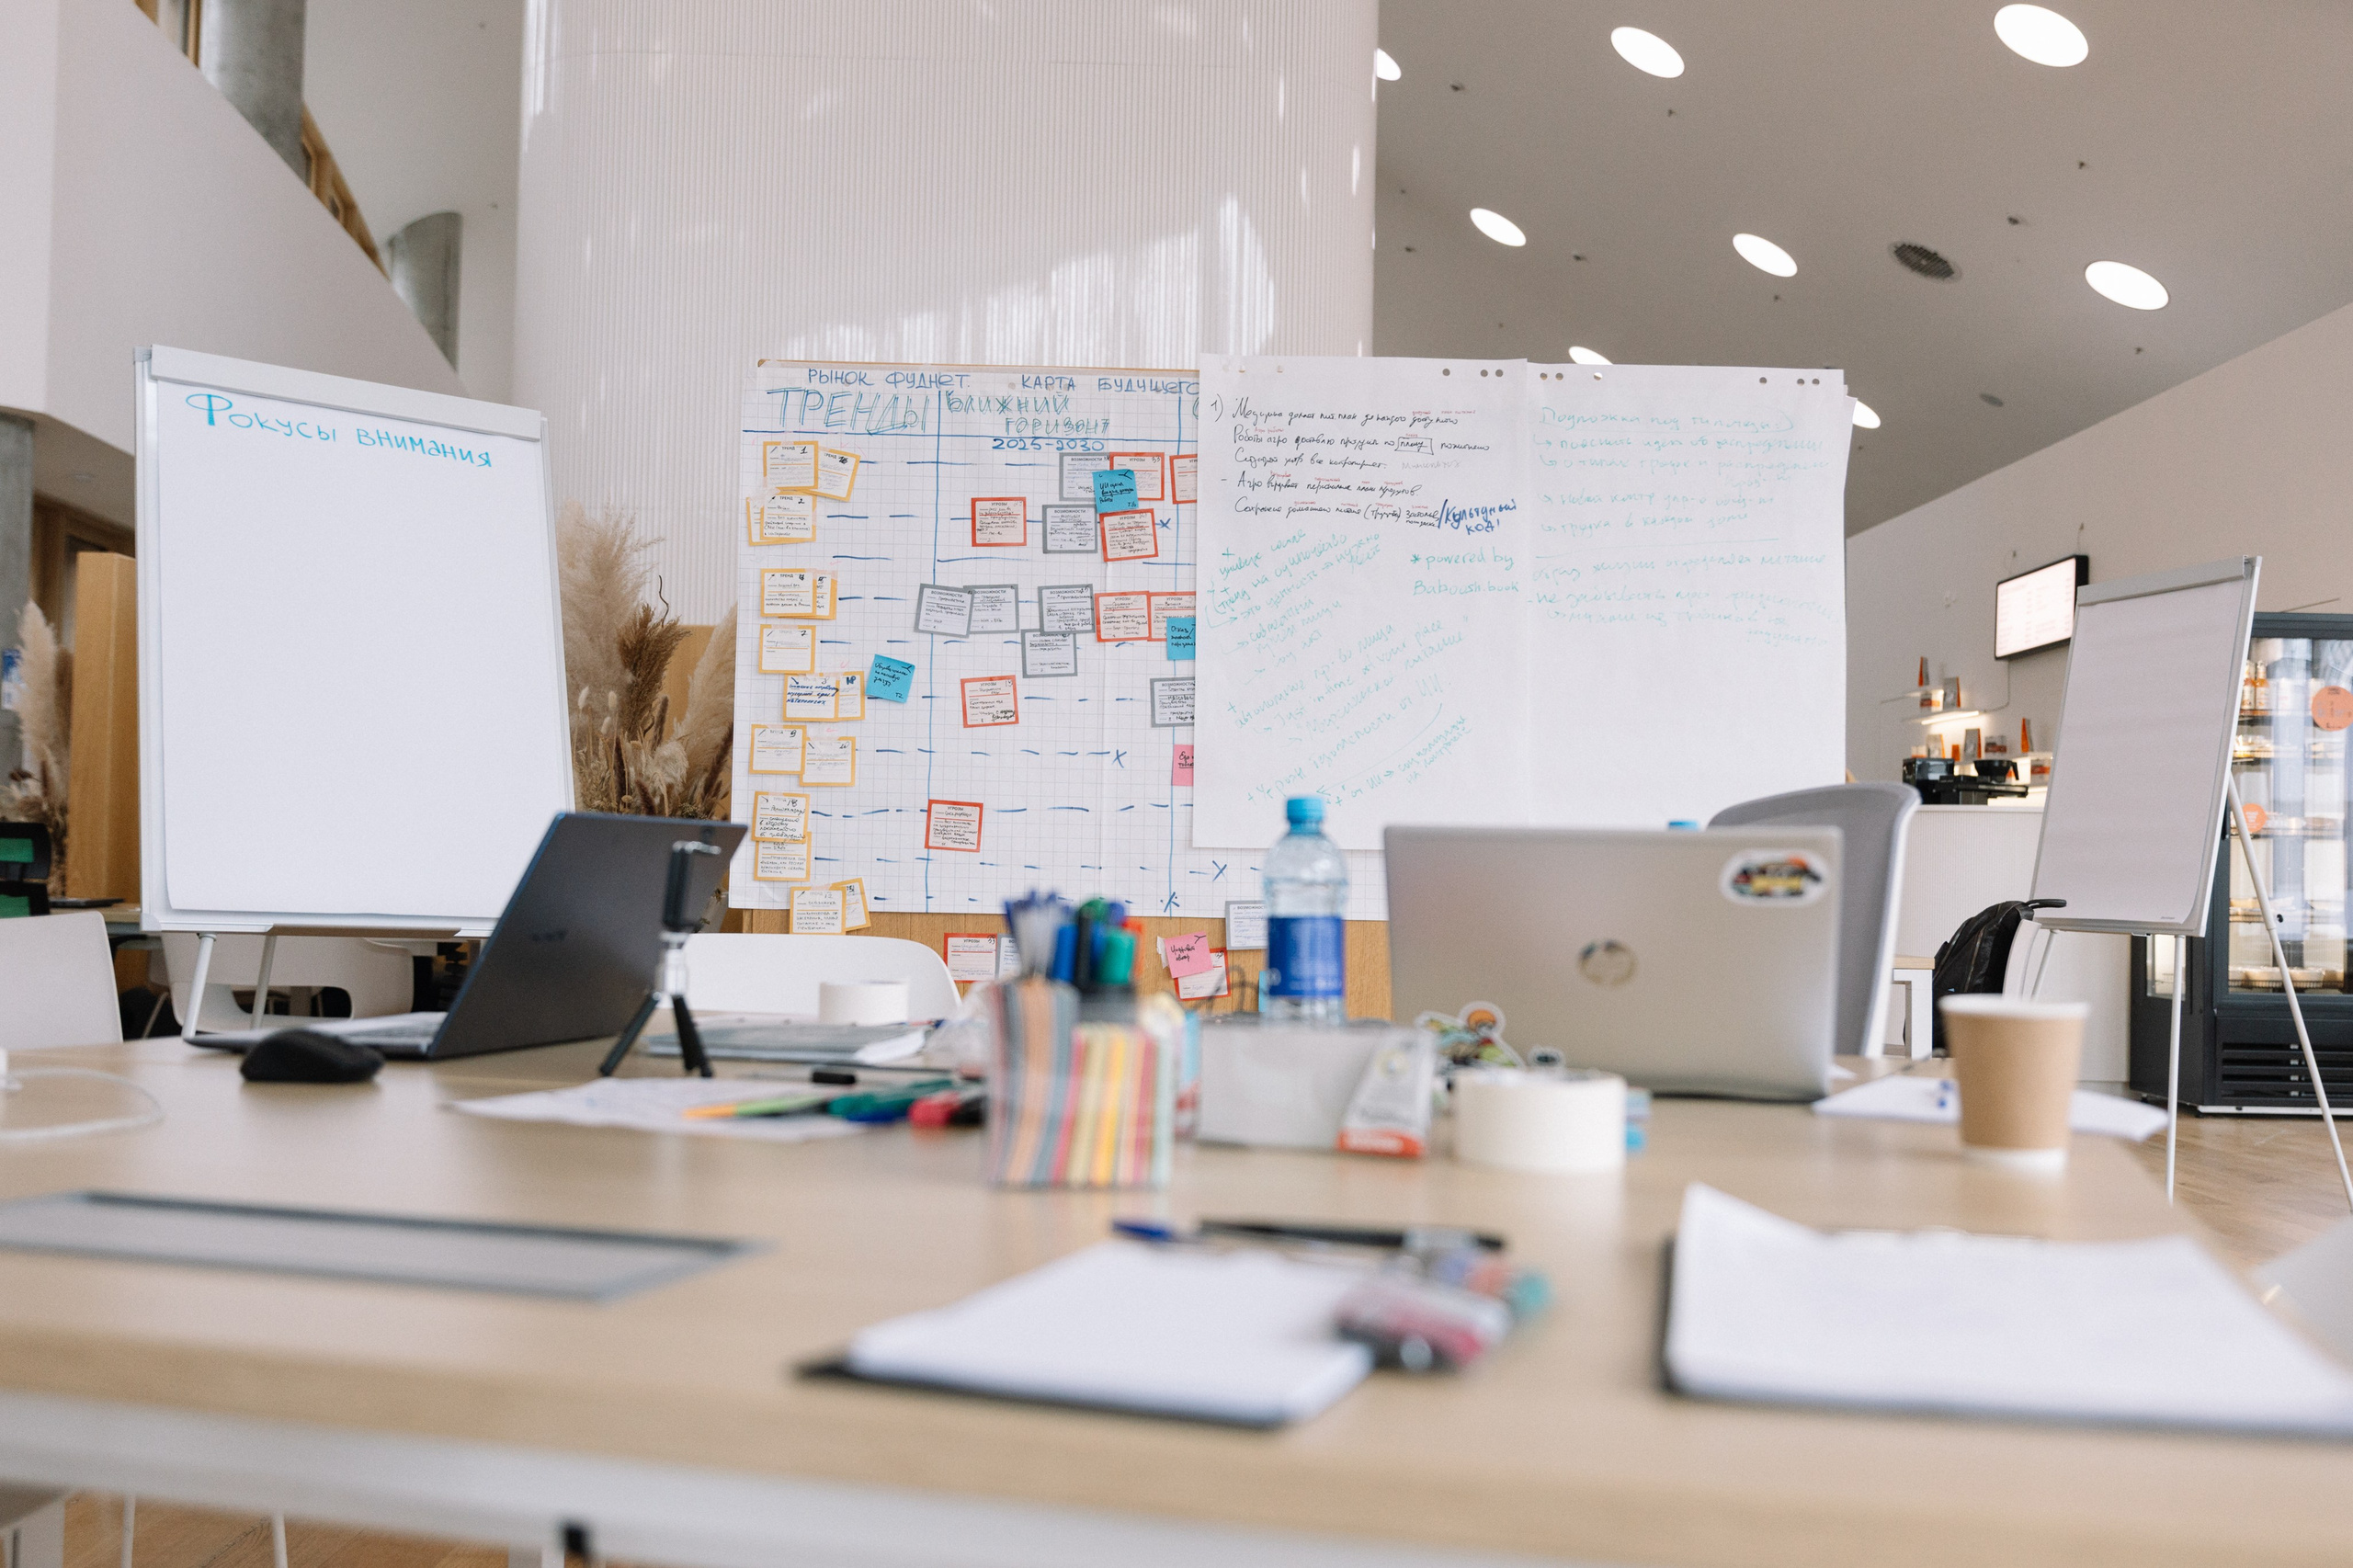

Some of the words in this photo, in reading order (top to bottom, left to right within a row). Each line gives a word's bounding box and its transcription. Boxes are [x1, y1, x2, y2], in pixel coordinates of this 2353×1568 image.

[808, 369, 876, 387] РЫНОК
[1020, 374, 1076, 392] КАРТА
[765, 386, 931, 437] ТРЕНДЫ
[945, 389, 1070, 416] БЛИЖНИЙ
[1211, 392, 1224, 423] 1)
[185, 392, 336, 443] Фокусы
[357, 427, 493, 468] внимания
[1005, 416, 1111, 437] ГОРИЗОНТ
[991, 437, 1106, 453] 2025-2030
[1425, 545, 1486, 571] powered
[1492, 545, 1515, 572] by
[930, 590, 963, 598] ВОЗМОЖНОСТИ
